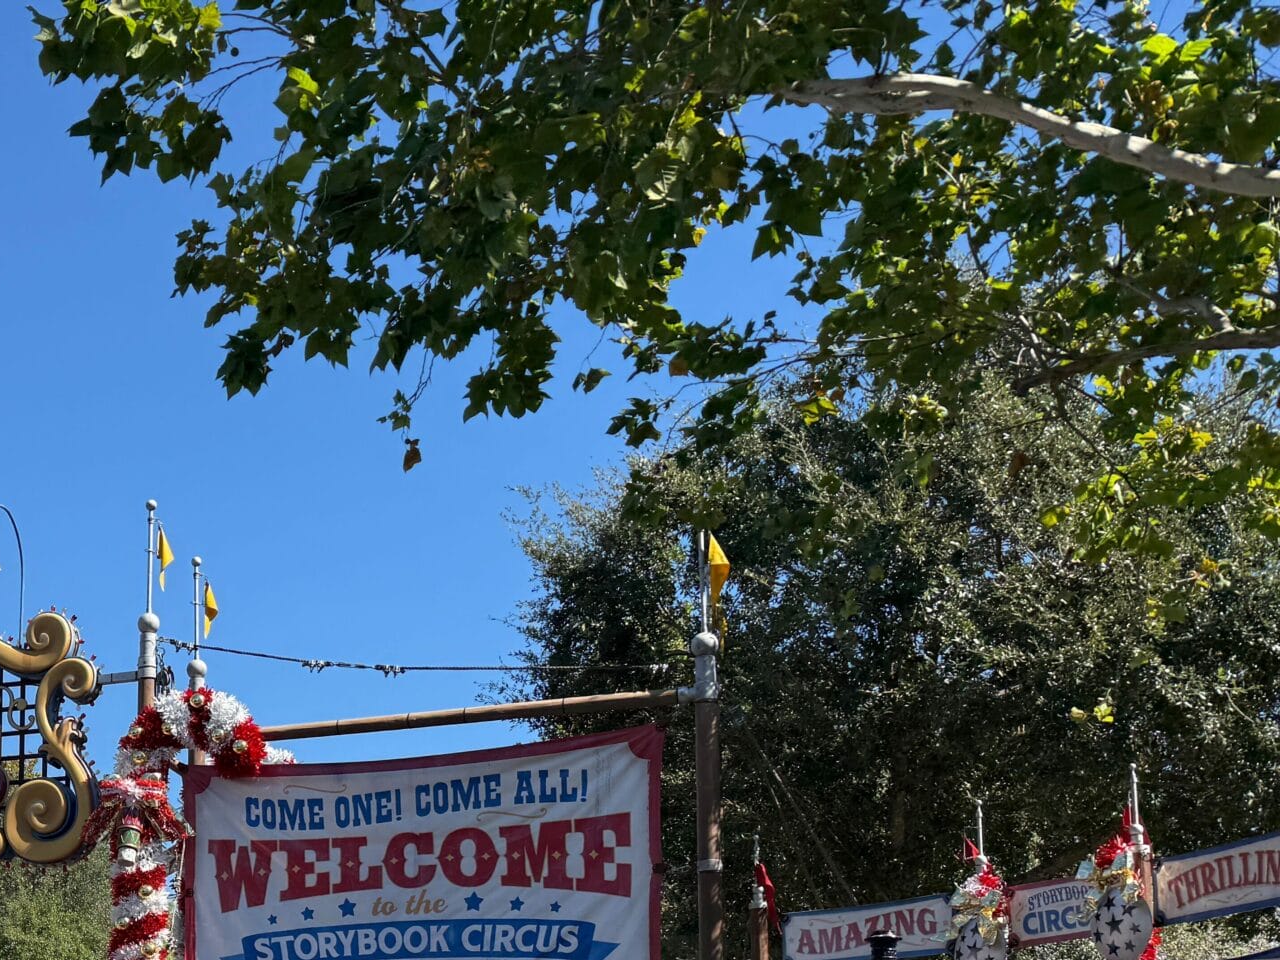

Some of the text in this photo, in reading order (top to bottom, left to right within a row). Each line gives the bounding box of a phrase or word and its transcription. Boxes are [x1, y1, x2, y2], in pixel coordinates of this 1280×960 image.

[245, 769, 589, 831] COME ONE! COME ALL!
[208, 811, 631, 913] WELCOME
[371, 890, 448, 917] to the
[1028, 885, 1094, 911] STORYBOO
[797, 907, 937, 954] AMAZING
[1023, 905, 1091, 935] CIRCU
[461, 924, 579, 955] CIRCUS
